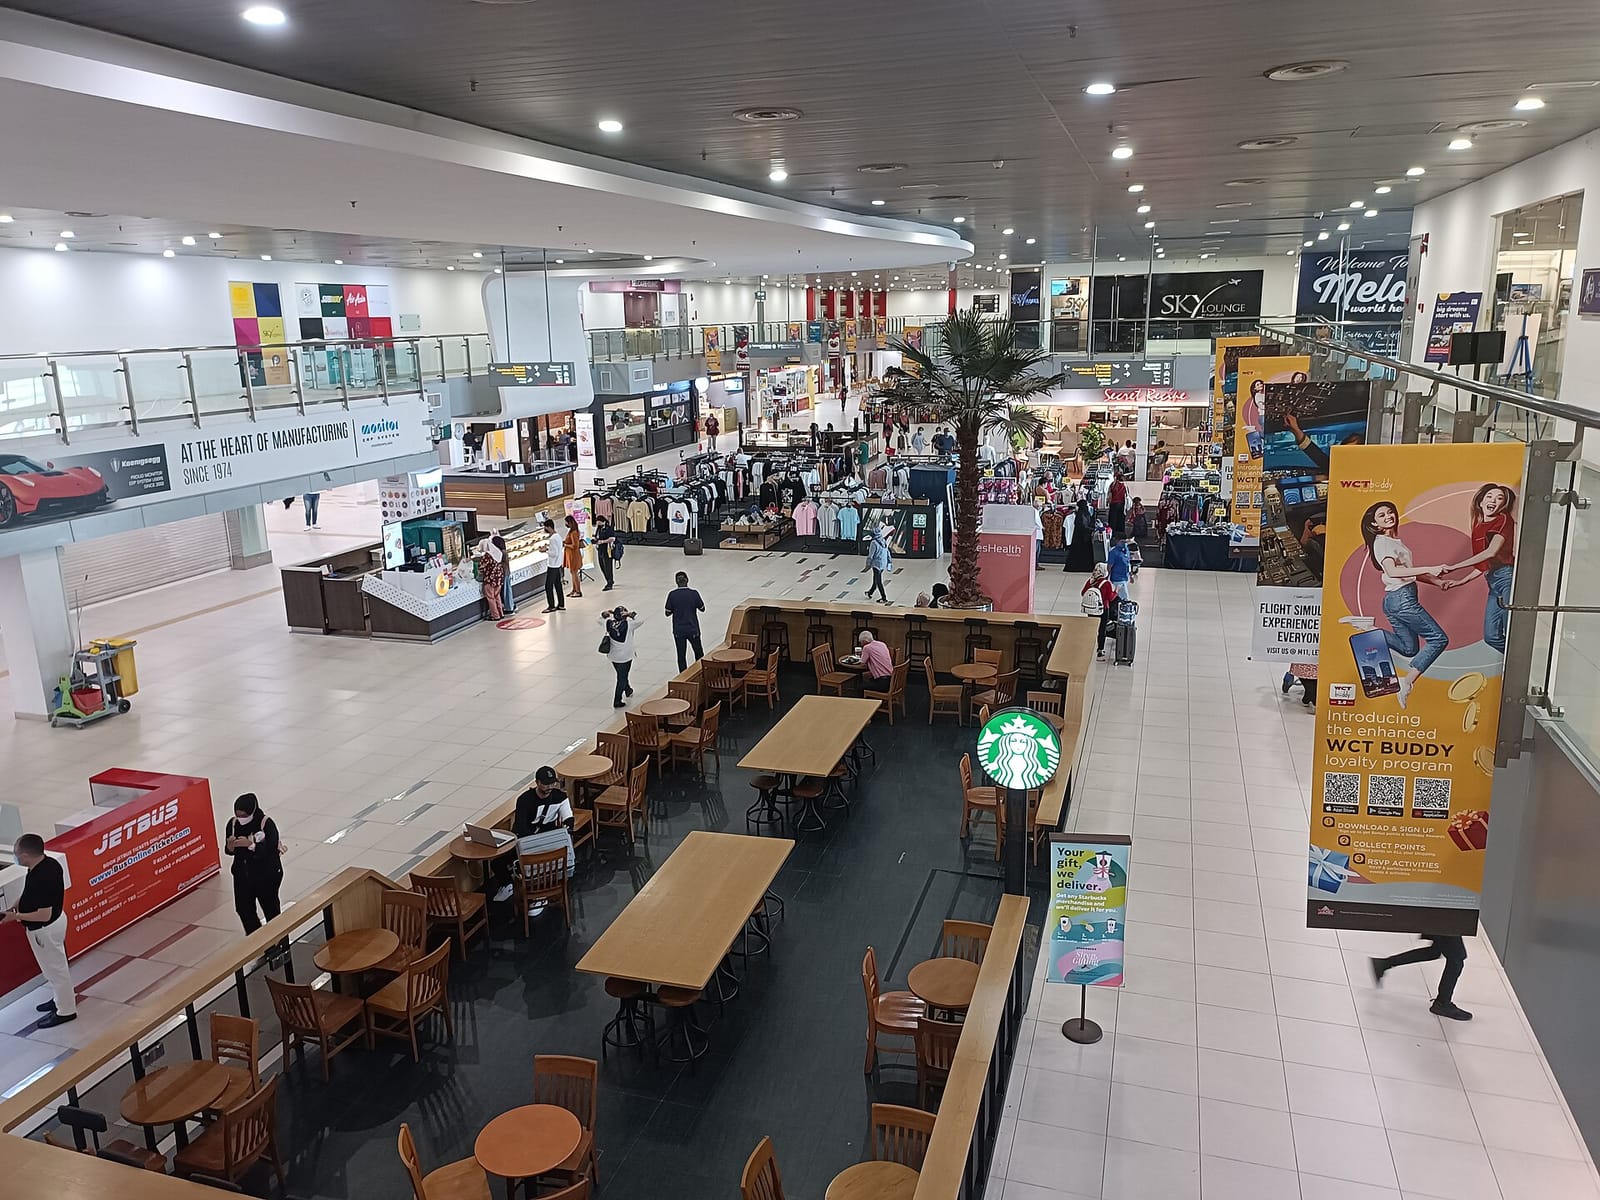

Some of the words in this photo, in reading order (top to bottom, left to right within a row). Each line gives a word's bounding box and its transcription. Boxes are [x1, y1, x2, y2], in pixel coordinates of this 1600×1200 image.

[1160, 294, 1201, 318] SKY
[1201, 303, 1246, 313] LOUNGE
[1350, 303, 1386, 313] world
[1103, 388, 1141, 401] Secret
[1146, 388, 1186, 402] Recipe
[180, 443, 194, 464] AT
[196, 439, 217, 461] THE
[219, 436, 254, 457] HEART
[256, 433, 269, 452] OF
[272, 421, 349, 449] MANUFACTURING
[121, 456, 160, 467] Koenigsegg
[183, 463, 209, 485] SINCE
[212, 461, 232, 480] 1974
[1260, 603, 1292, 615] FLIGHT
[1262, 617, 1319, 629] EXPERIENCE
[1277, 631, 1319, 643] EVERYON
[1327, 710, 1421, 727] Introducing
[1327, 725, 1352, 736] the
[1357, 726, 1437, 740] enhanced
[1327, 739, 1374, 753] WCT
[1381, 742, 1454, 757] BUDDY
[1325, 755, 1378, 770] loyalty
[1383, 760, 1453, 772] program
[93, 798, 179, 856] JETBUS
[1338, 822, 1389, 832] DOWNLOAD
[1353, 841, 1392, 849] COLLECT
[1394, 843, 1426, 851] POINTS
[90, 828, 190, 884] www.BusOnlineTicket.com
[1057, 847, 1085, 858] Your
[1056, 858, 1082, 870] gift,
[1367, 858, 1390, 866] RSVP
[1392, 860, 1439, 869] ACTIVITIES
[1056, 879, 1102, 891] deliver.
